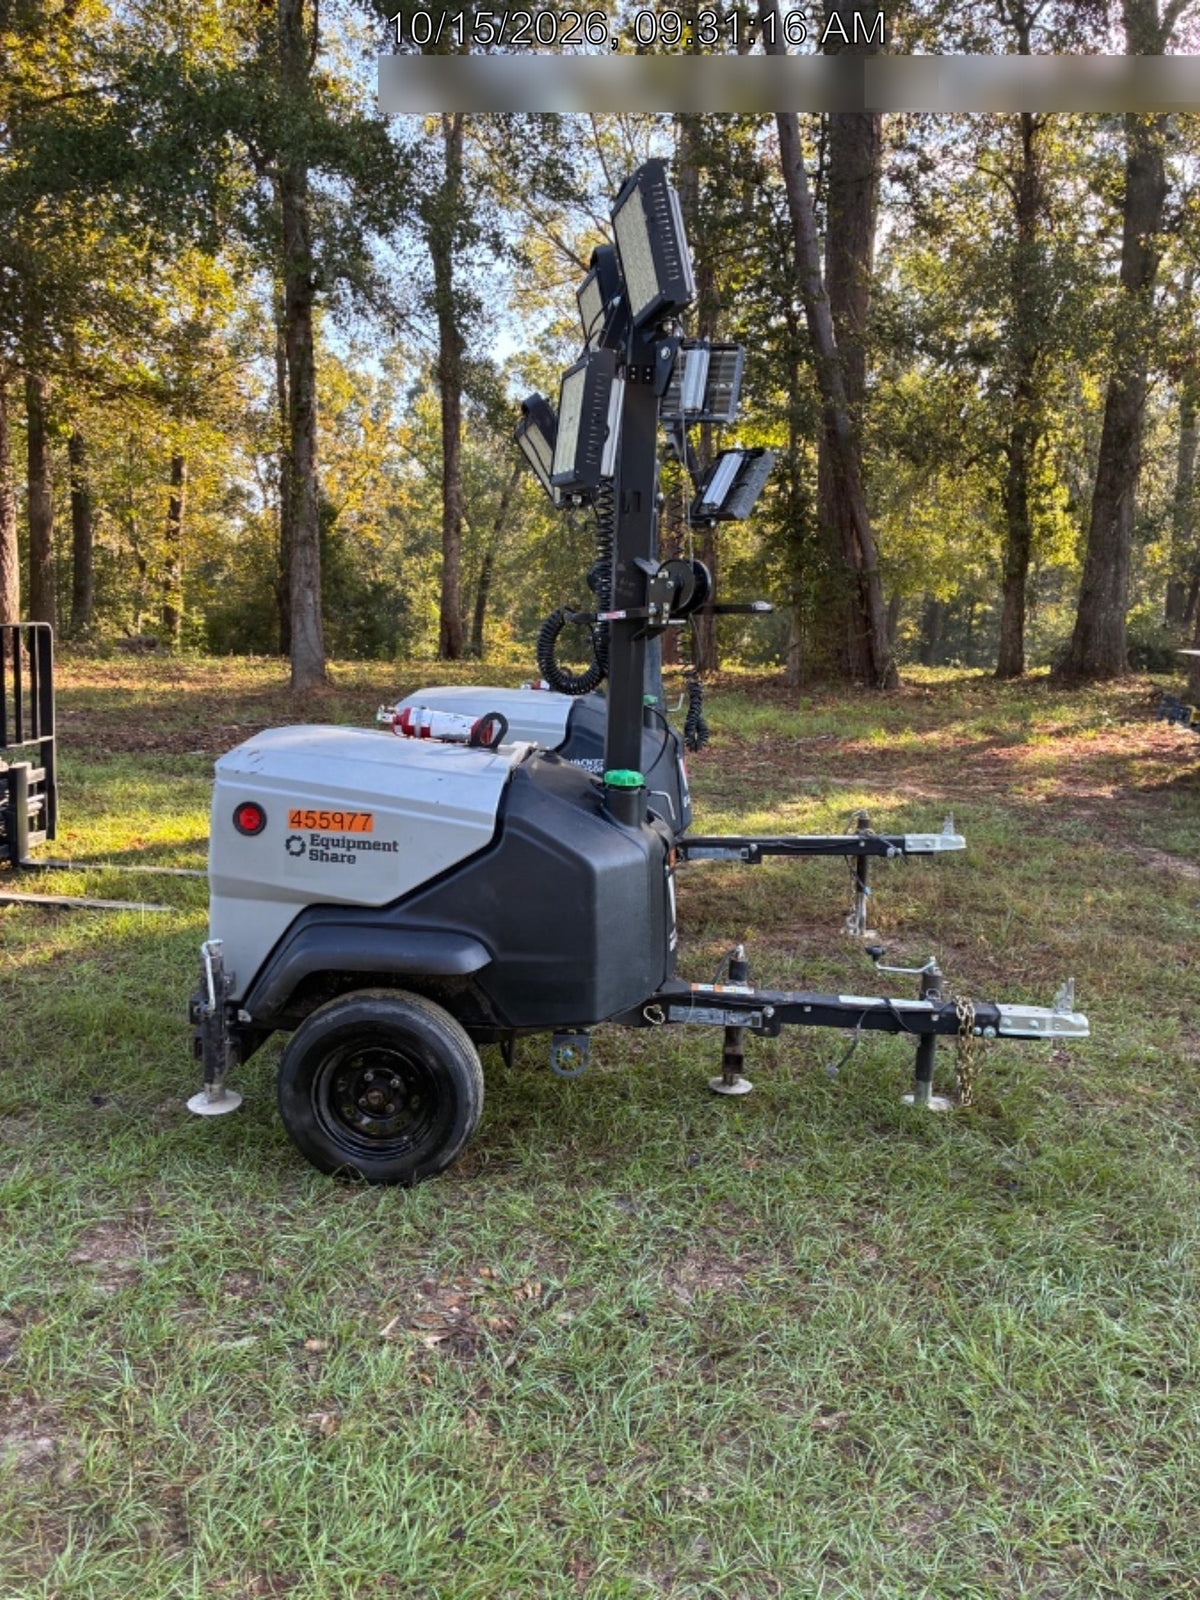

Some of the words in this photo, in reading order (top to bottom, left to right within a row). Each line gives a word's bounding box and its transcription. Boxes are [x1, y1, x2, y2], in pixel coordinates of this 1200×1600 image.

[290, 810, 372, 831] 455977
[309, 834, 399, 852] Equipment
[309, 849, 357, 864] Share
